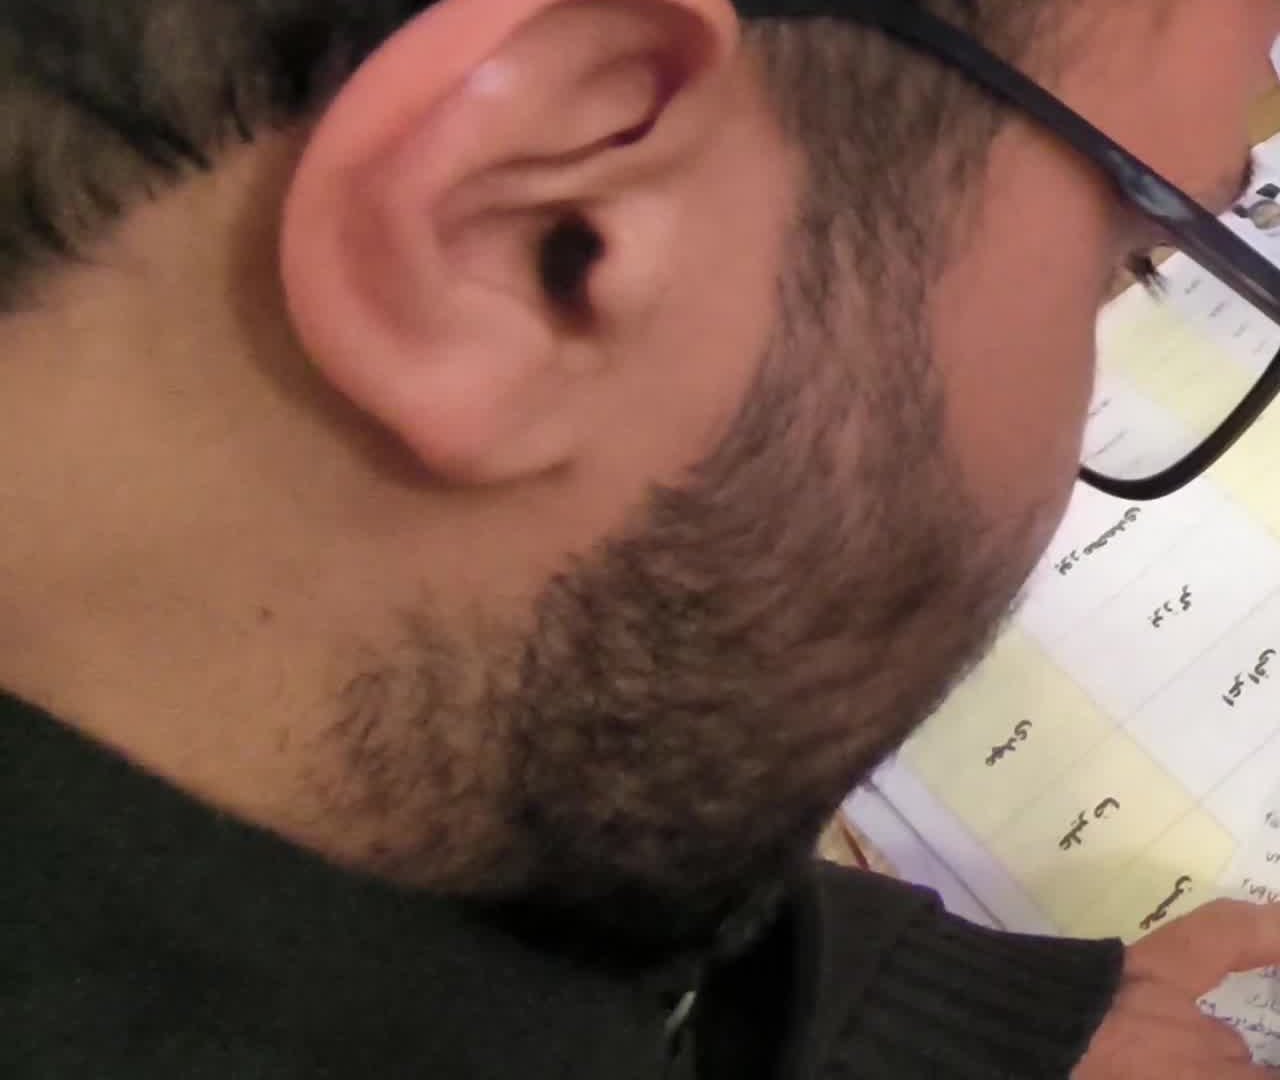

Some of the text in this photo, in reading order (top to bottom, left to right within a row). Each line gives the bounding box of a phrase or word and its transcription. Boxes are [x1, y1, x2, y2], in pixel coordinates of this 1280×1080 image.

[1151, 585, 1192, 629] برزگر
[1222, 648, 1276, 707] اعرافی
[985, 719, 1032, 766] مهدی
[1058, 797, 1120, 851] علیرضا
[1139, 875, 1191, 946] محسن
